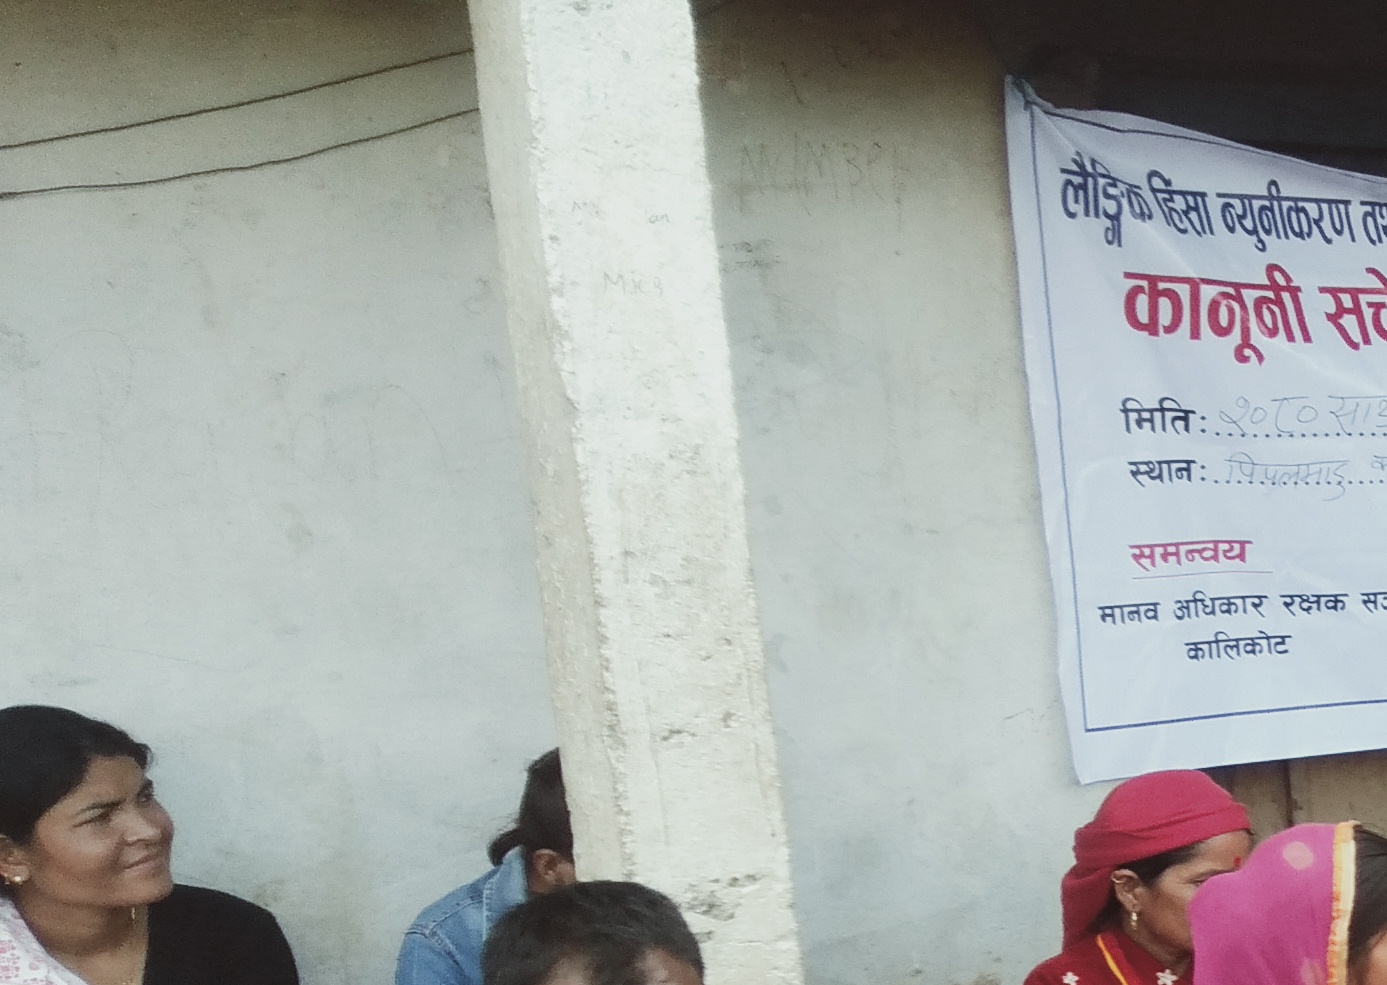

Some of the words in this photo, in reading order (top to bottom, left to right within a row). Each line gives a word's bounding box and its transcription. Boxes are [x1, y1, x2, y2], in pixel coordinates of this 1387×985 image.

[1147, 169, 1215, 238] हिंसा
[1123, 263, 1313, 365] कानूनी
[1119, 396, 1207, 436] मिति:
[1127, 458, 1207, 488] स्थान:
[1128, 539, 1254, 572] समन्वय
[1097, 601, 1161, 625] मानव
[1173, 590, 1270, 621] अधिकार
[1278, 592, 1350, 616] रक्षक
[1185, 630, 1292, 662] कालिकोट
